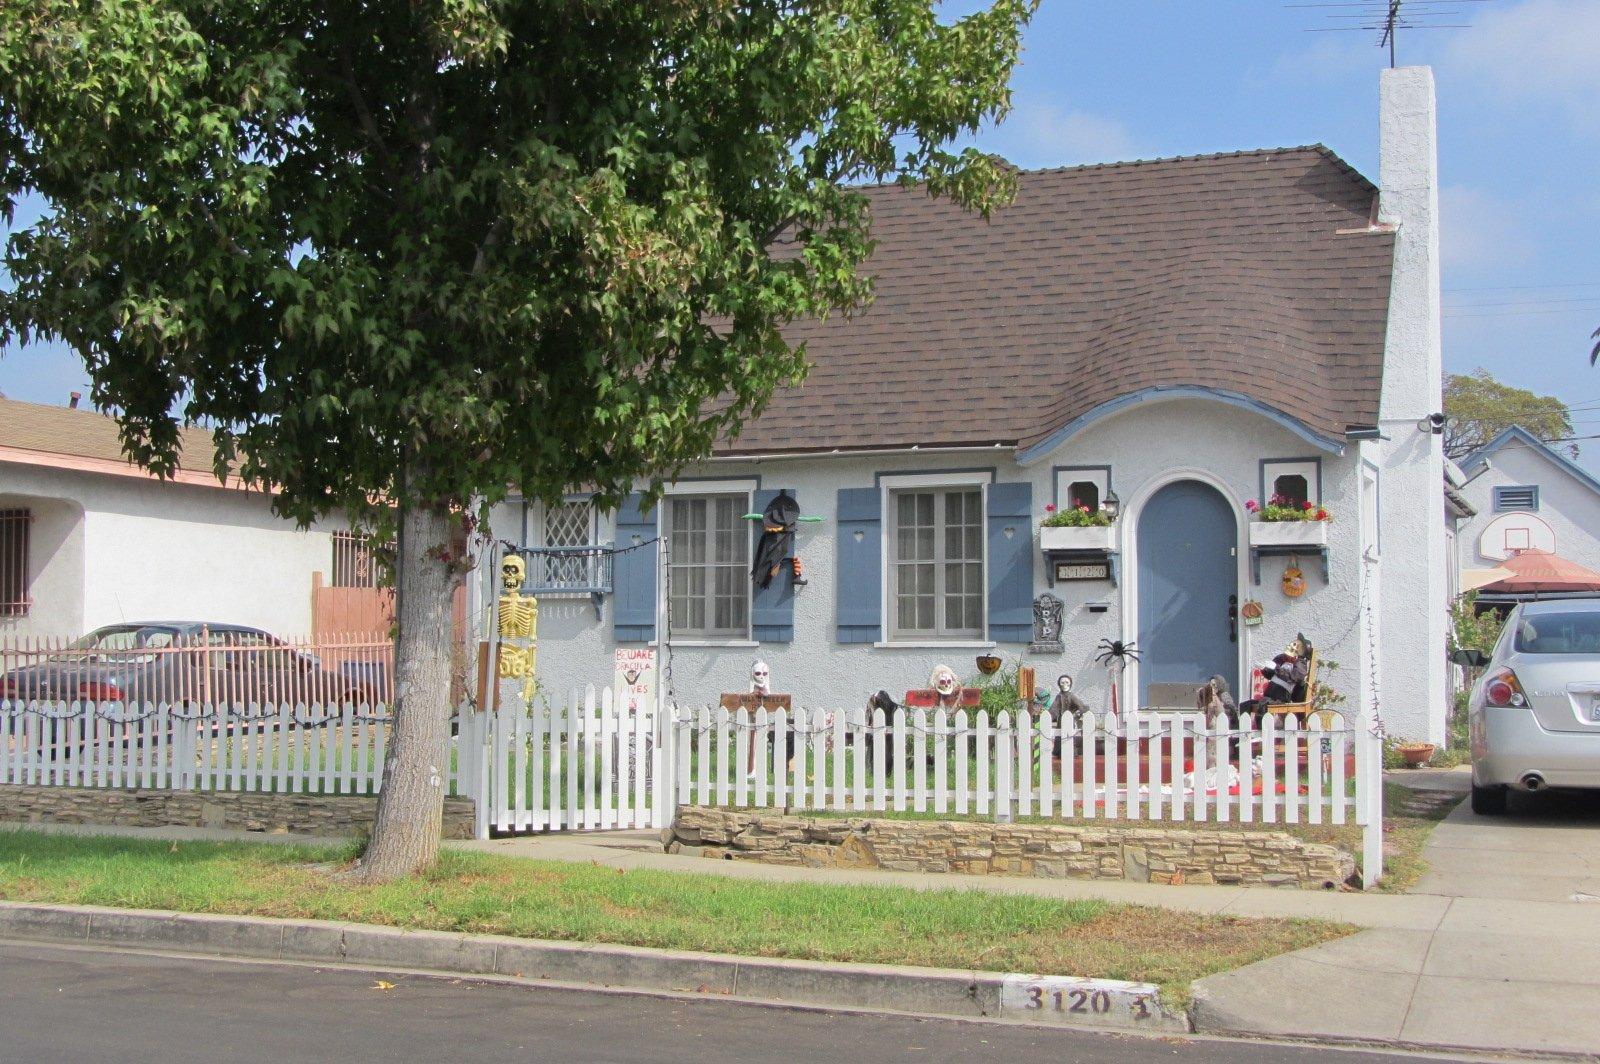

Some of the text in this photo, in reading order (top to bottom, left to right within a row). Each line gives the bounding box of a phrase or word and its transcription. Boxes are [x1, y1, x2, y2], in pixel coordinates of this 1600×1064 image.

[1061, 567, 1105, 577] 3120
[616, 650, 654, 660] BEWARE
[1025, 986, 1111, 1013] 3120
